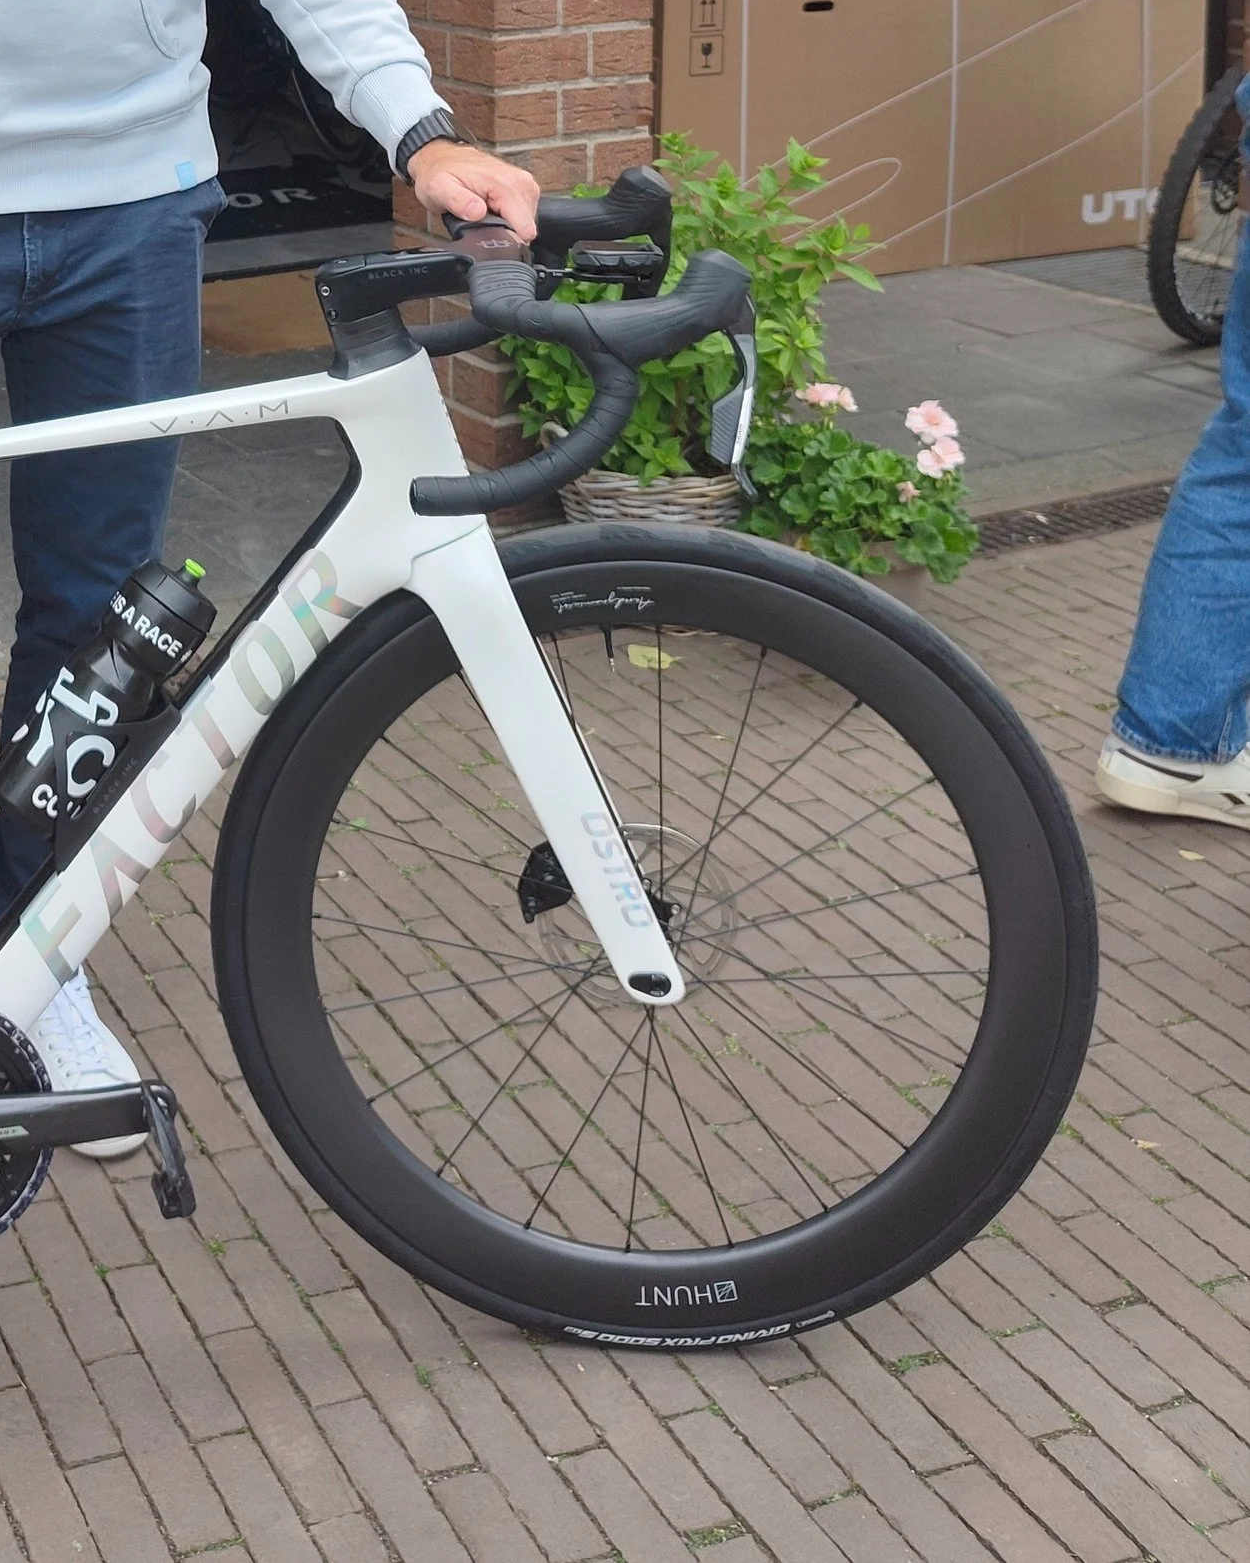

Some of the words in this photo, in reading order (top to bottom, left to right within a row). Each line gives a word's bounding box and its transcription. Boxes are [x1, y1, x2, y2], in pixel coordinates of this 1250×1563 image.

[368, 269, 405, 281] BLACK
[409, 265, 429, 276] INC
[121, 606, 134, 626] A
[134, 614, 183, 659] RACE
[20, 548, 364, 986] FACTOR
[581, 812, 654, 928] OSTRO
[634, 1284, 713, 1307] HUNT
